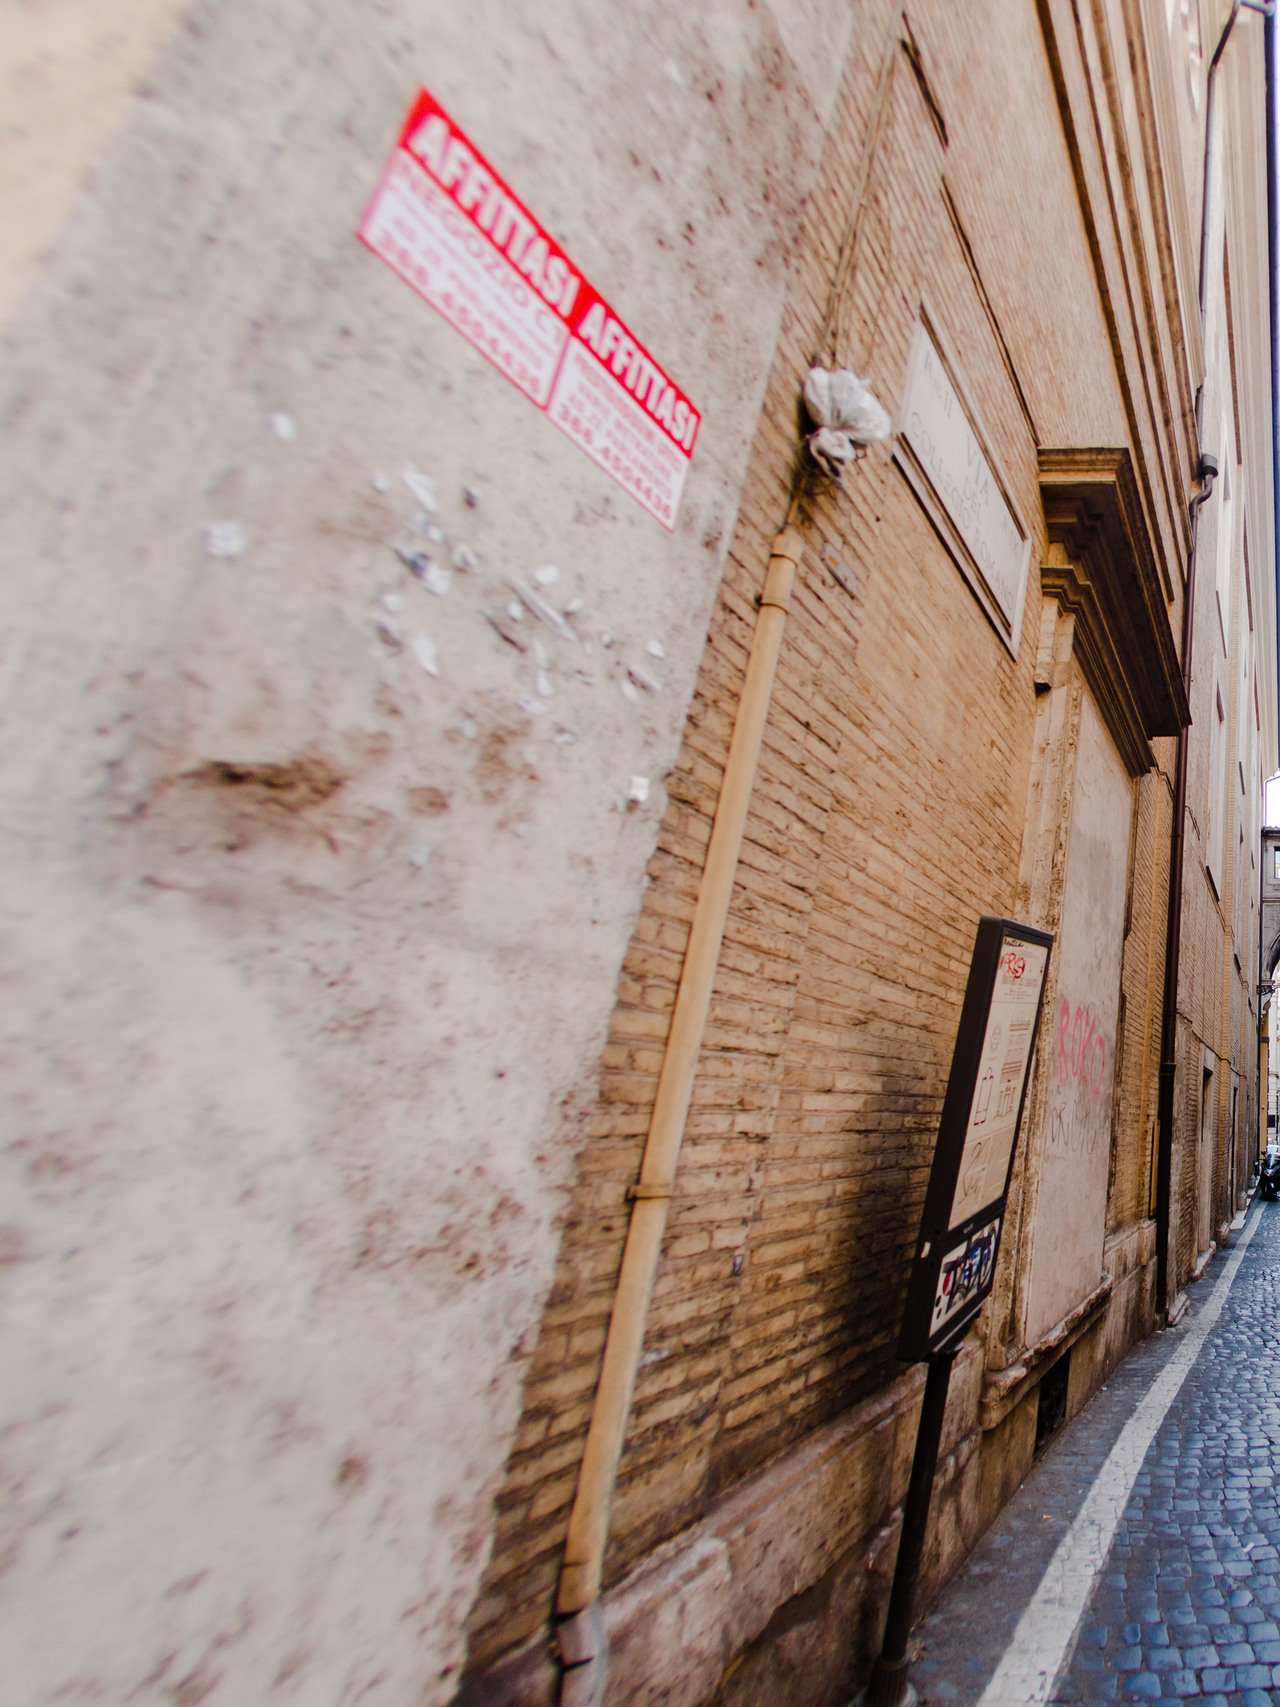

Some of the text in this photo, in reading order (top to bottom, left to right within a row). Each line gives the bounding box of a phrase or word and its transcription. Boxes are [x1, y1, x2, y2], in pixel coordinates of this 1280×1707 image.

[396, 160, 532, 313] NEGOZIO
[409, 110, 580, 319] AFFITTASI
[577, 300, 696, 453] AFFITTASI
[909, 404, 972, 534] COLLEGIO
[962, 473, 983, 527] DEL
[963, 434, 991, 507] VIA
